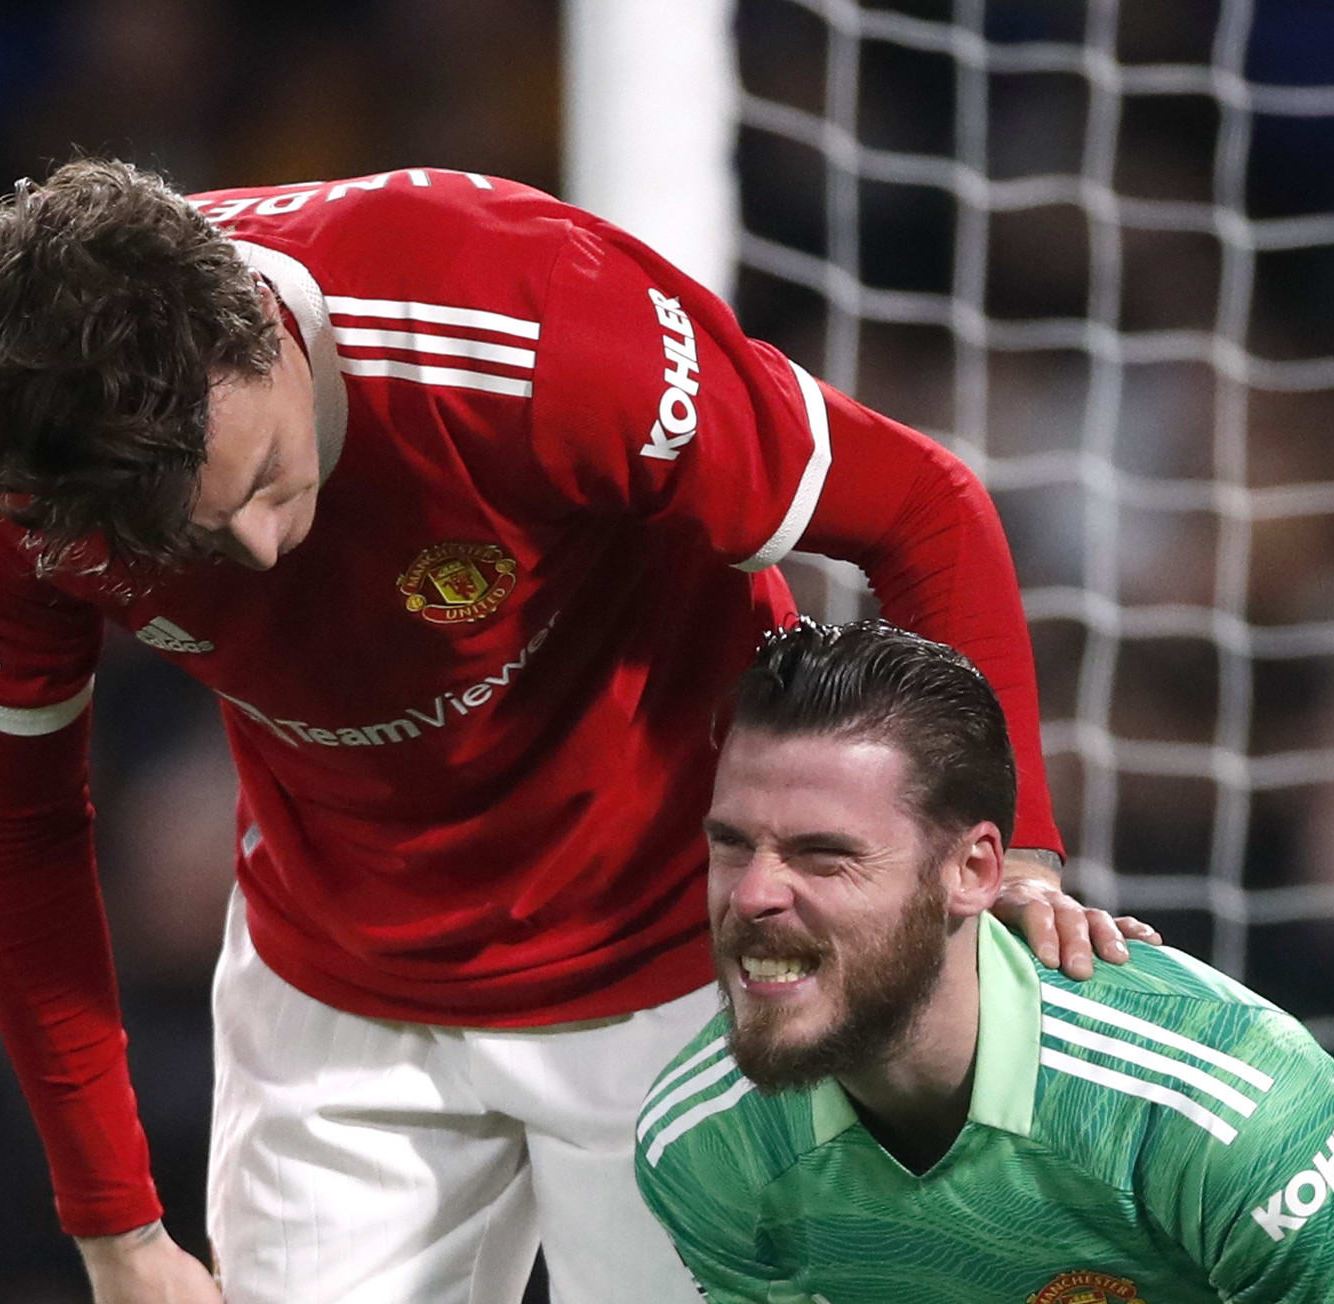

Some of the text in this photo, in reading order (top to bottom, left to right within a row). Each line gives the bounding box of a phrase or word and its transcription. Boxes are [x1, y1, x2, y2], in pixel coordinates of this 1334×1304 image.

[640, 287, 700, 461] KOHLER
[445, 587, 506, 619] UNITED
[274, 609, 561, 747] TeamViewer
